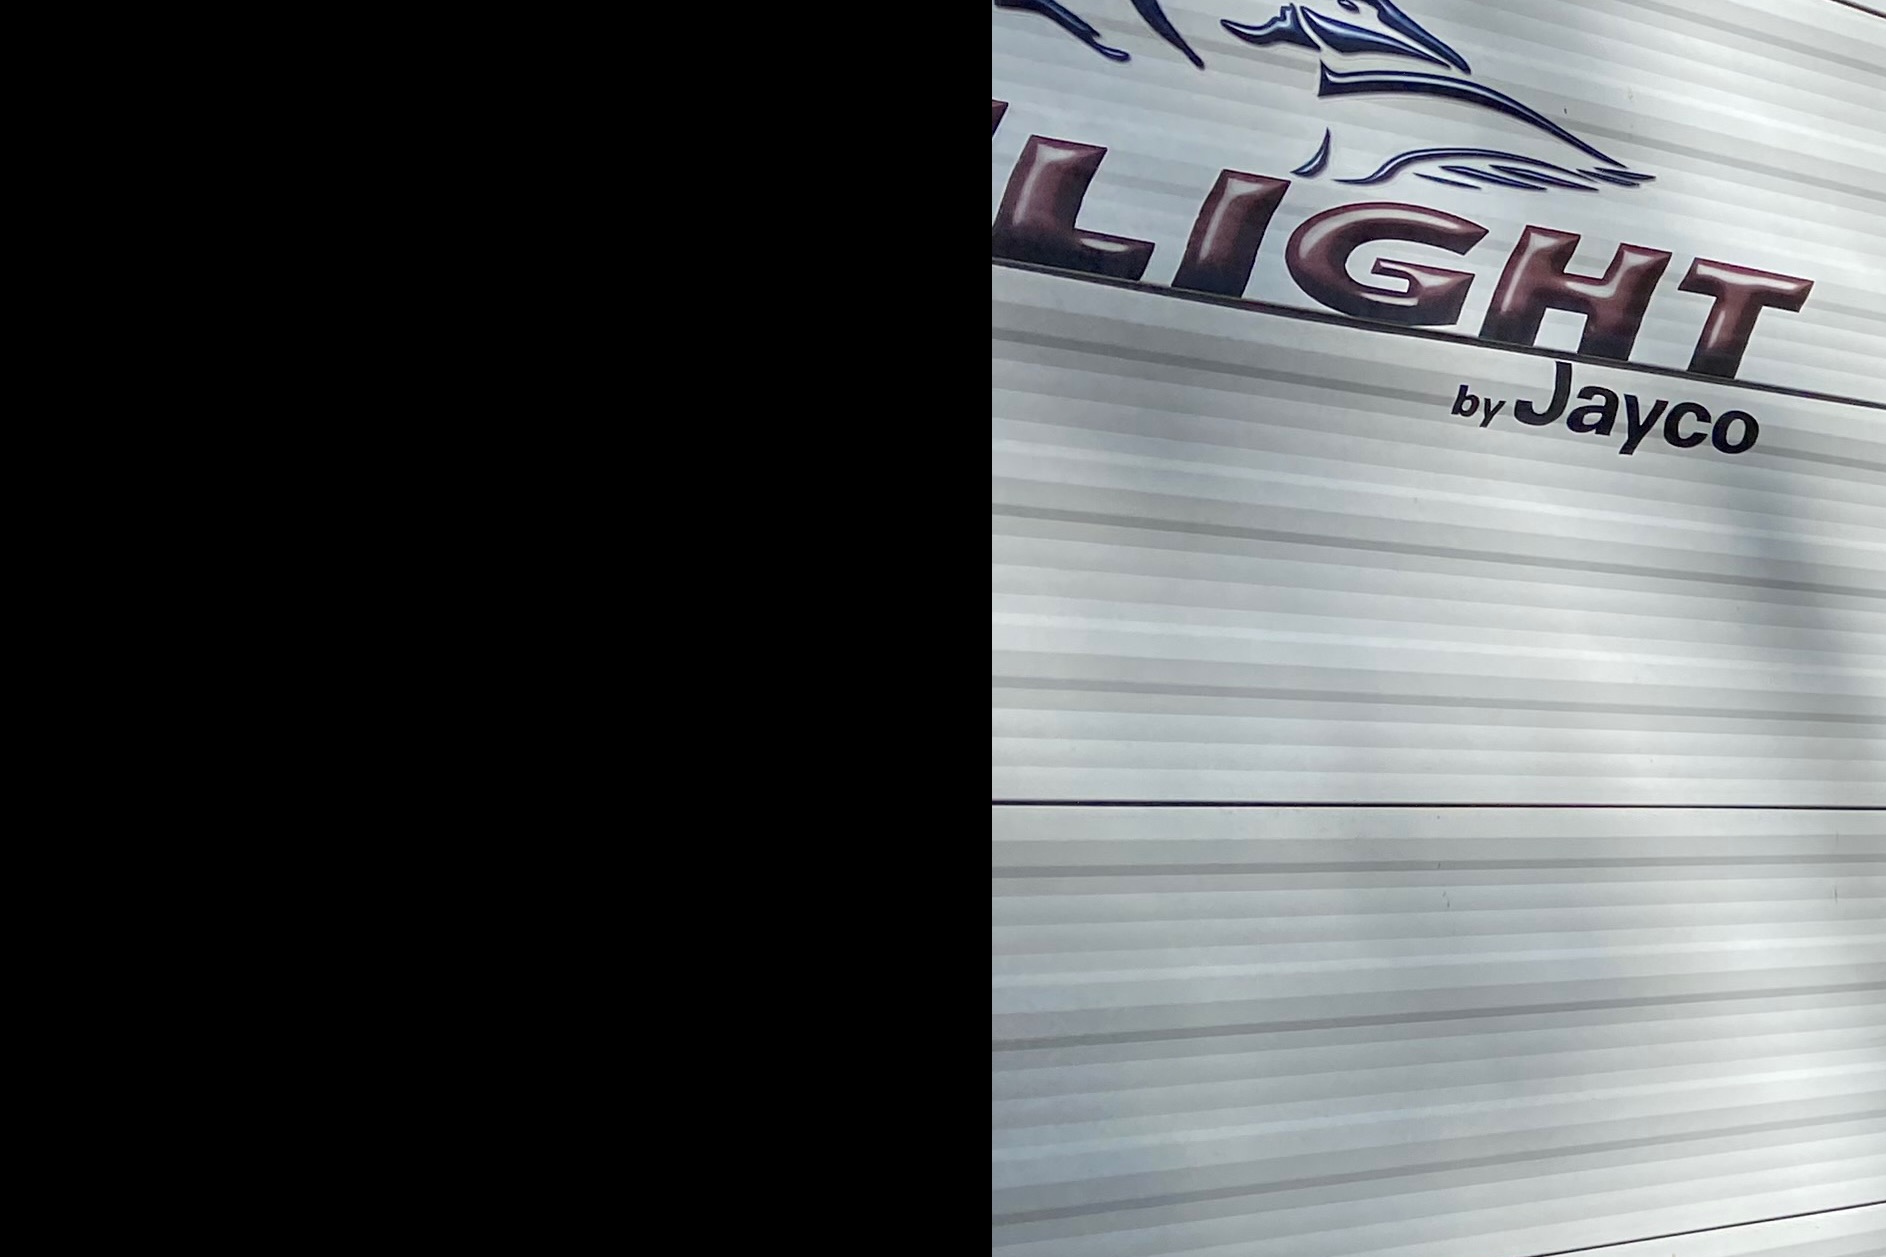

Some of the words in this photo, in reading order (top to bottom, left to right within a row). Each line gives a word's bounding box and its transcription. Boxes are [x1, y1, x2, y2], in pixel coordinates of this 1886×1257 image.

[993, 99, 1815, 380] LIGHT
[1451, 385, 1506, 428] by
[1514, 361, 1760, 456] Jayco
